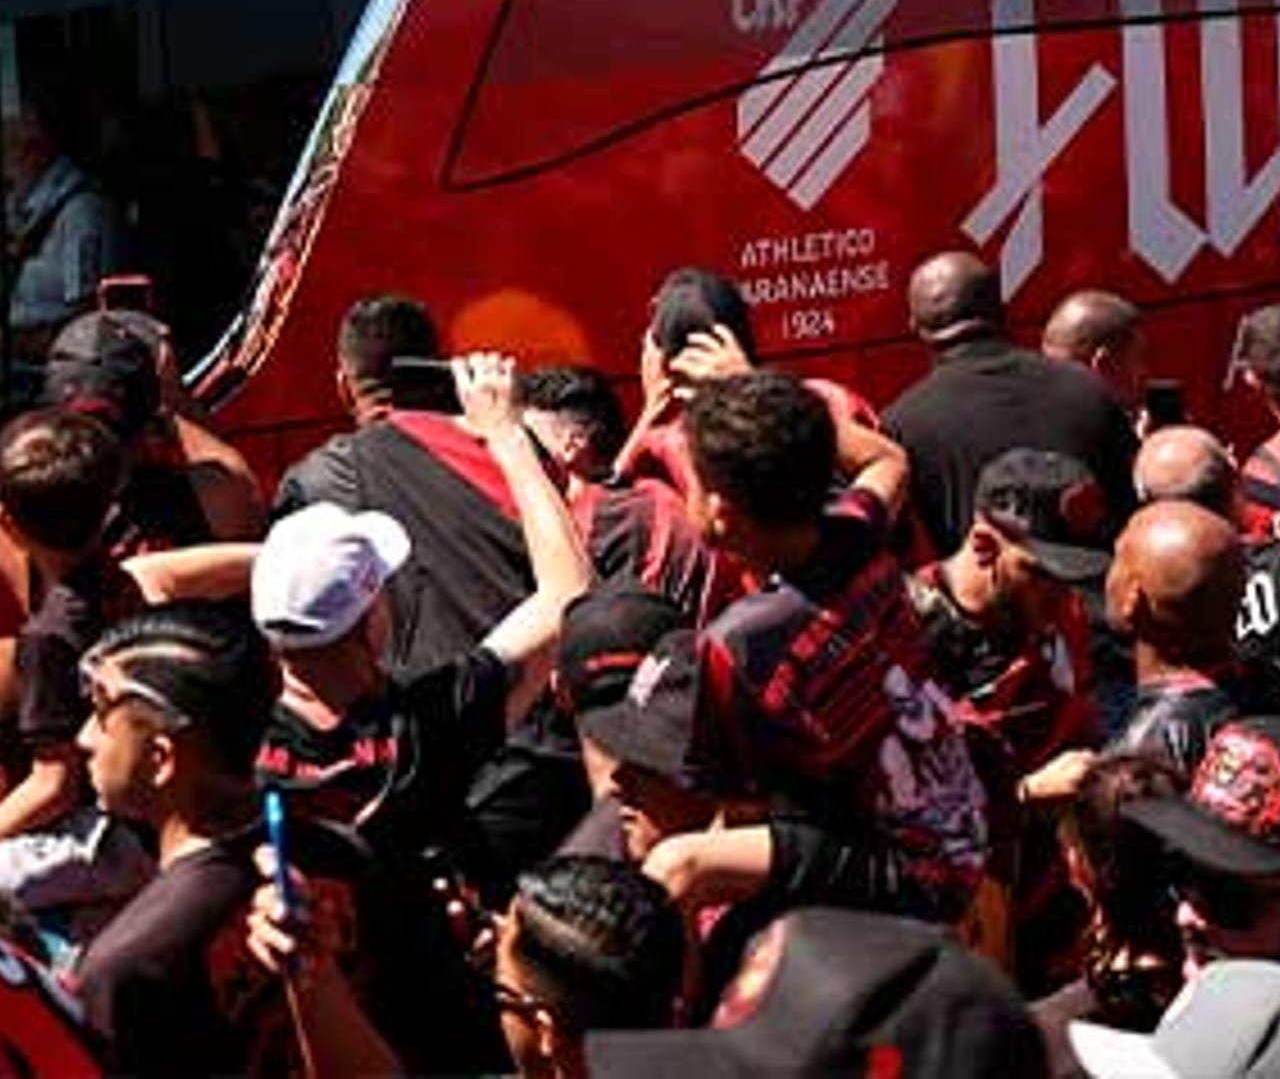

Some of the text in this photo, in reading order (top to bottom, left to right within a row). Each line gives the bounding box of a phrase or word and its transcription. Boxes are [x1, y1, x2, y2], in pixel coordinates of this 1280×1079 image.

[740, 228, 876, 269] ATHLETICO
[738, 260, 890, 304] ARANAENSE
[782, 309, 835, 340] 1924
